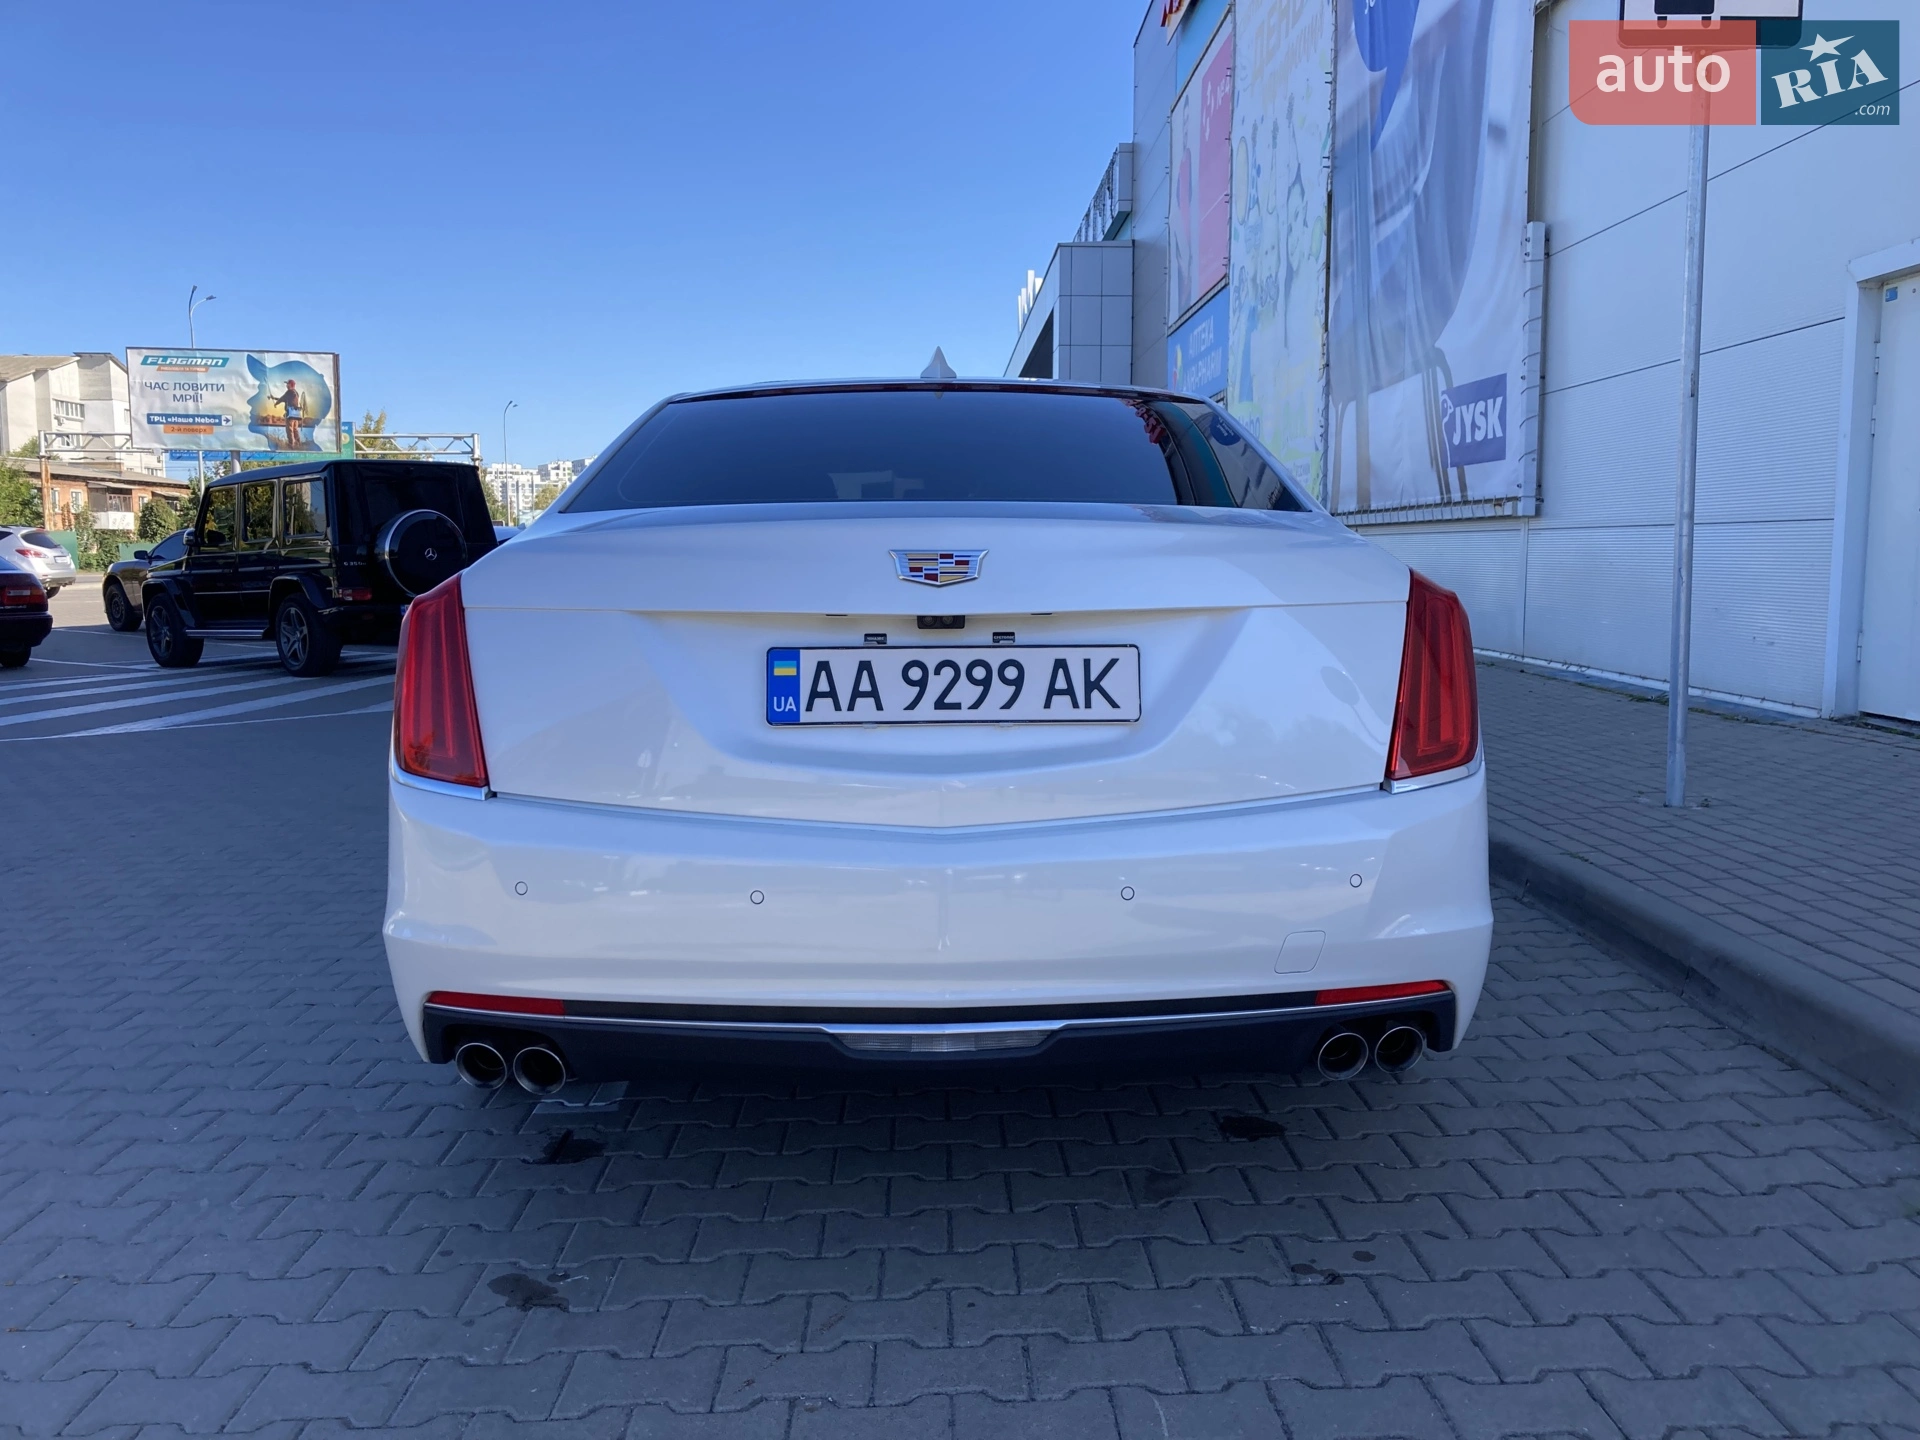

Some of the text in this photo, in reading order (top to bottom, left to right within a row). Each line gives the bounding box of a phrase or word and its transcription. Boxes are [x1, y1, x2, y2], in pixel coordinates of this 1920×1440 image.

[144, 381, 225, 392] ЧАС ЛОВИТИ
[172, 392, 203, 403] МРІЇ!
[149, 415, 166, 424] ТРЦ
[1452, 396, 1504, 446] JYSK
[805, 658, 1121, 712] AA 9299 AK
[773, 696, 797, 712] UA
